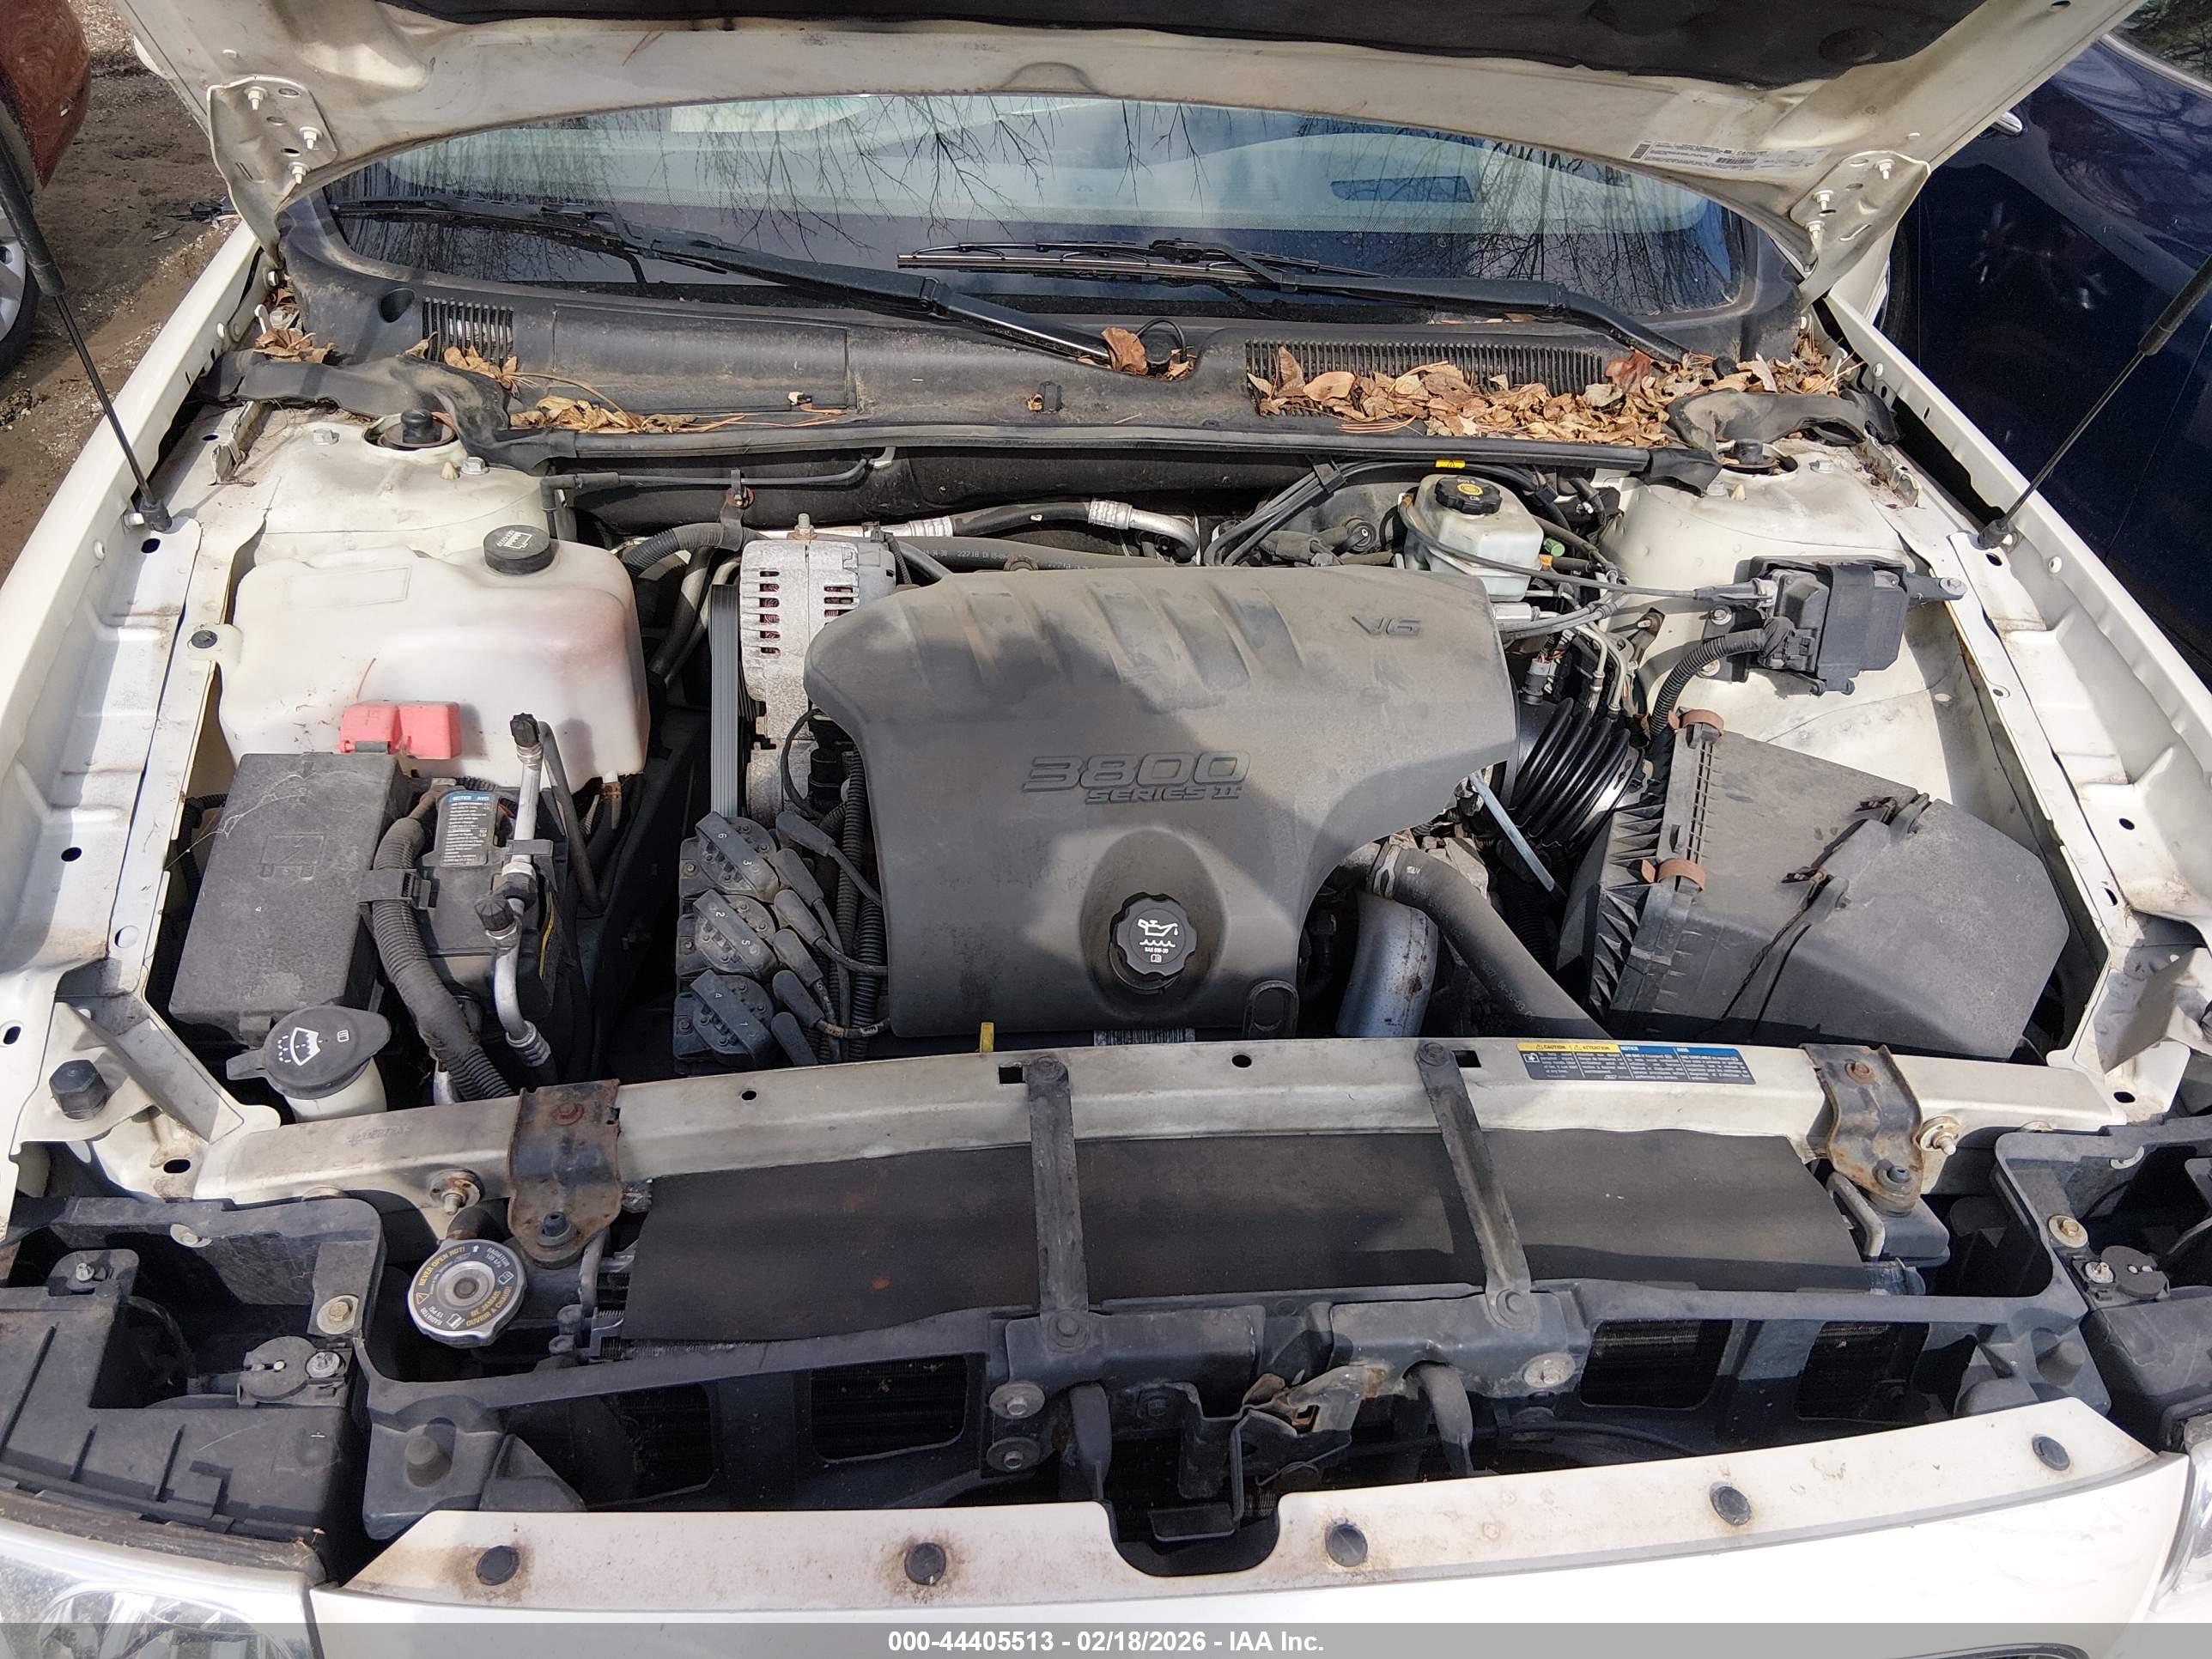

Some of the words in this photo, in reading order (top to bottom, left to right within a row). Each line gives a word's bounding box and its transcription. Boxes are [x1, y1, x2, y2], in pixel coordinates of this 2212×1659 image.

[1352, 615, 1422, 637] V6
[1022, 750, 1251, 794] 3800
[1085, 787, 1209, 805] SERIES
[1210, 785, 1244, 800] II
[418, 1267, 433, 1286] NEVER
[431, 1253, 448, 1267] OPEN
[448, 1246, 465, 1256] HOT!
[482, 1290, 501, 1310] JAMAIS
[420, 1307, 443, 1326] RADIATOR
[466, 1313, 490, 1327] OUVRIR
